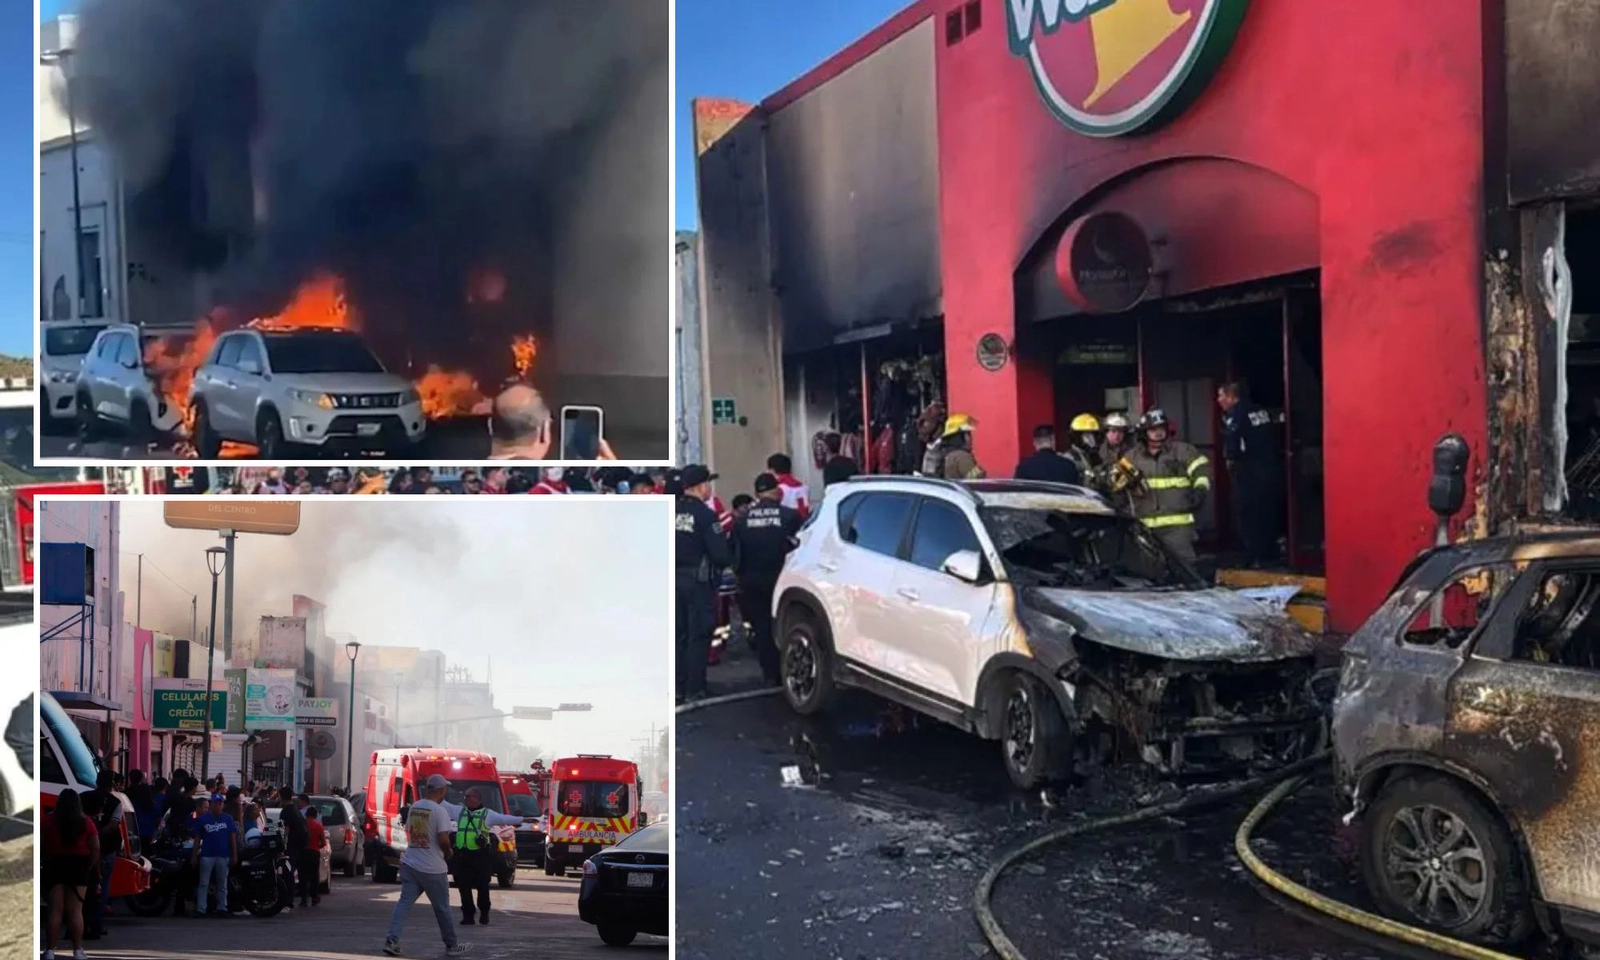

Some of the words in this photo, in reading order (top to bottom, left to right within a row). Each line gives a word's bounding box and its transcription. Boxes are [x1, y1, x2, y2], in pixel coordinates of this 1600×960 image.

[208, 504, 222, 513] DEL
[224, 505, 257, 515] CENTRO
[186, 701, 194, 709] A
[298, 700, 333, 708] PAYJOY
[204, 822, 227, 833] Dodgers
[568, 831, 616, 839] AMBULANCIA
